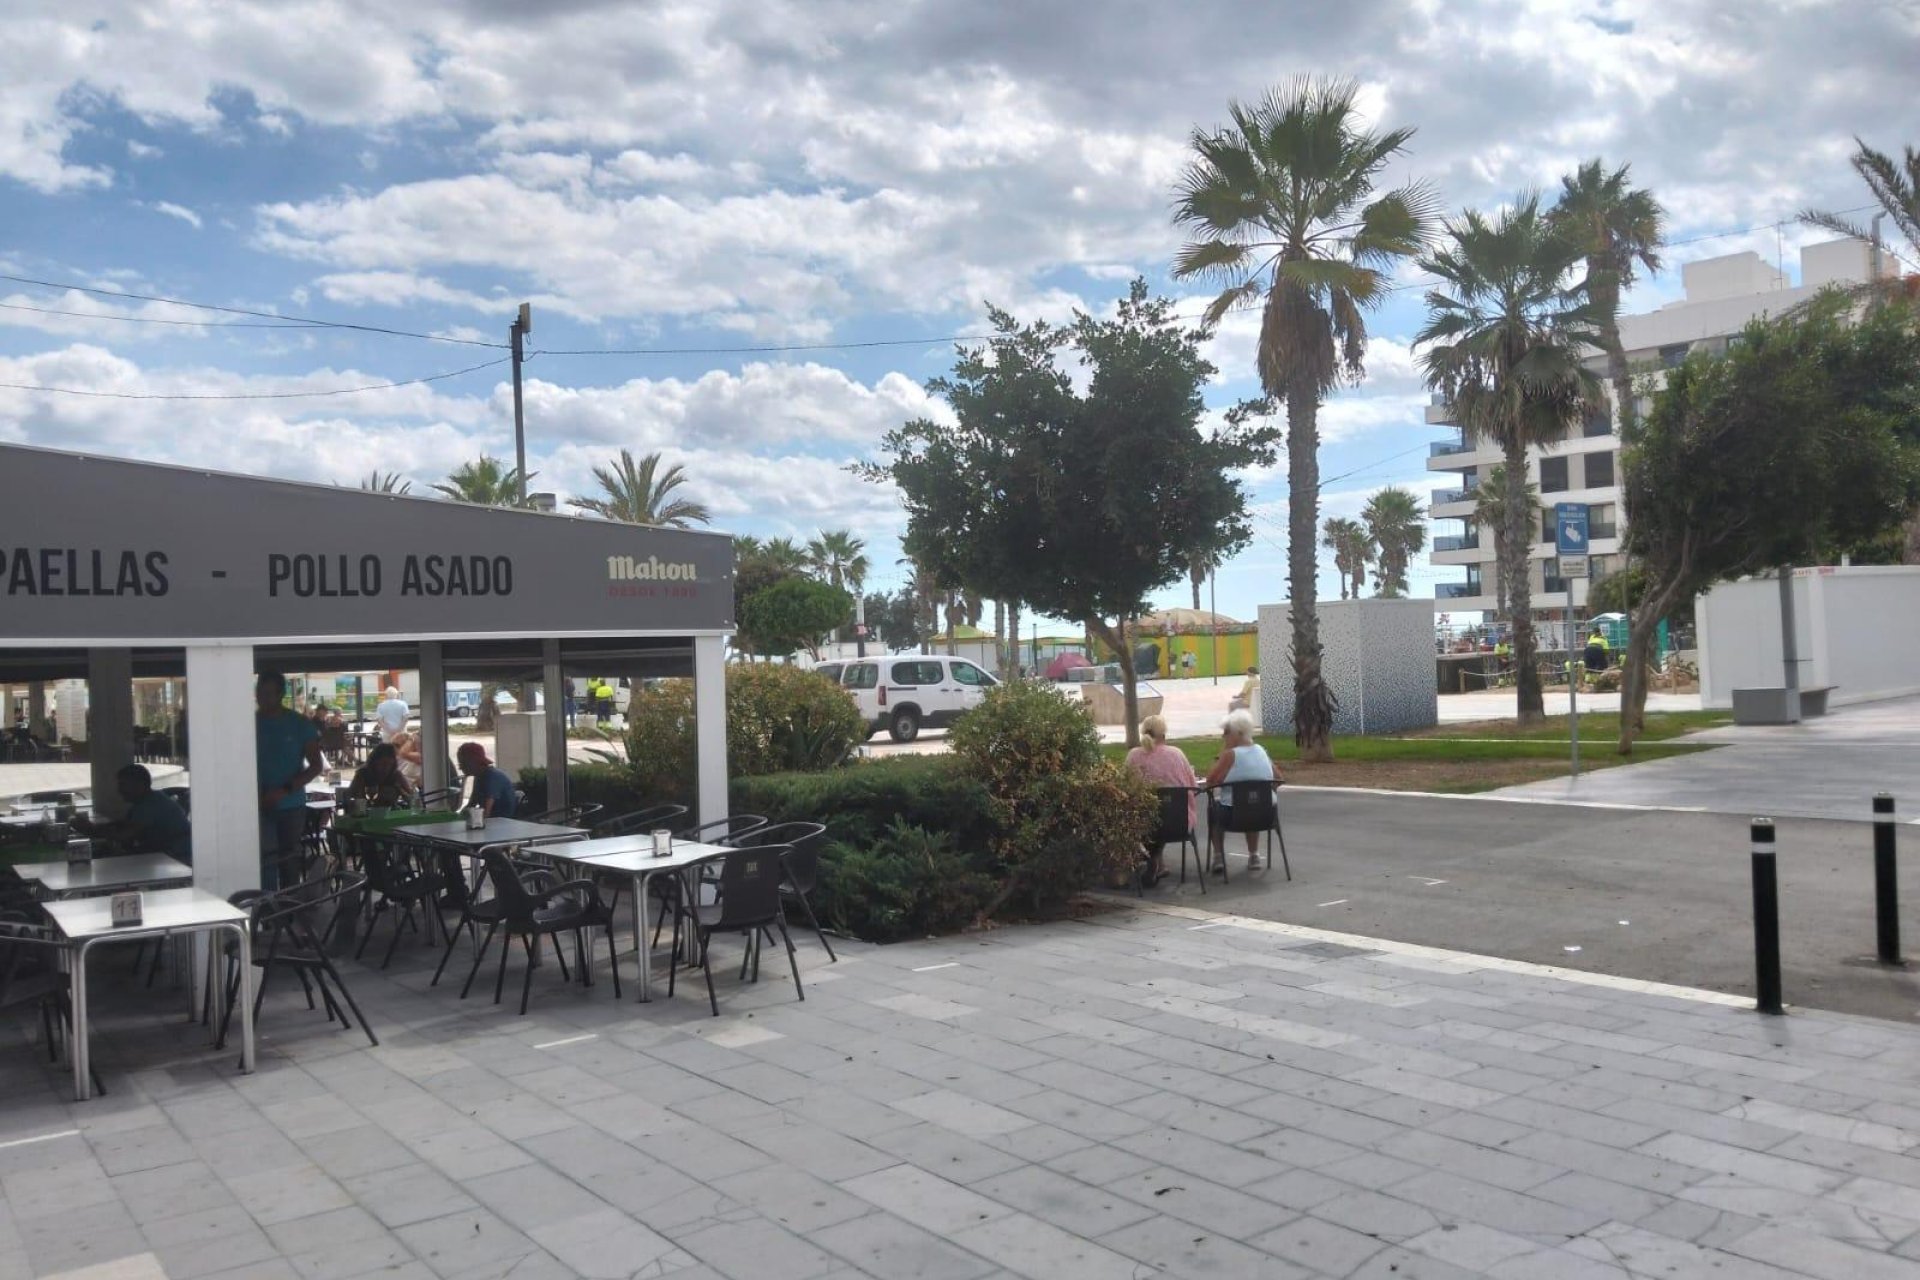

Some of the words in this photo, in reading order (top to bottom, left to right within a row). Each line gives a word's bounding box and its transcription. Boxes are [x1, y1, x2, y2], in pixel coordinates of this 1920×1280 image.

[0, 547, 169, 597] AELLAS
[268, 553, 382, 597] POLLO
[401, 554, 513, 596] ASADO
[607, 555, 697, 580] Mahou
